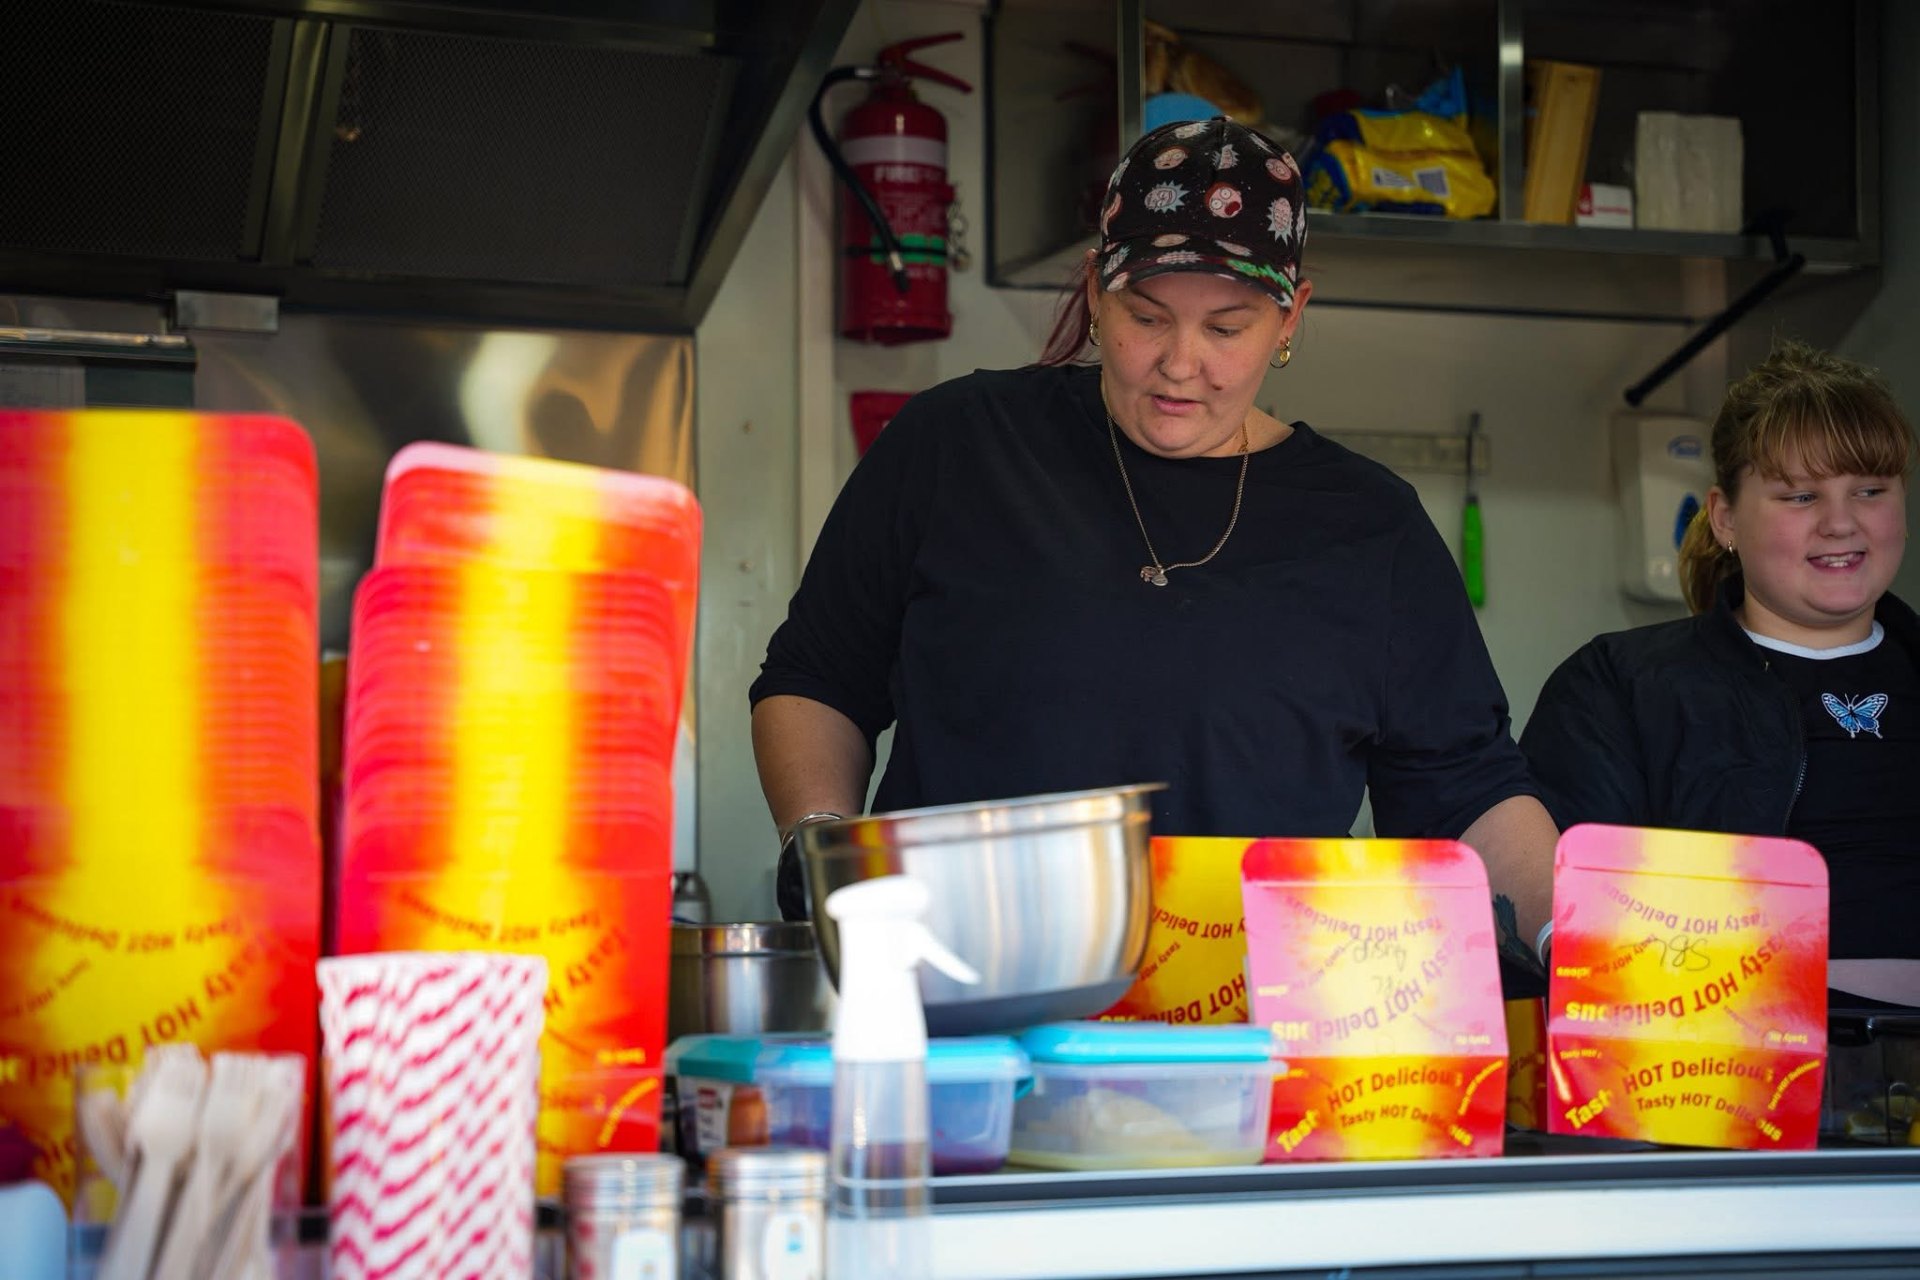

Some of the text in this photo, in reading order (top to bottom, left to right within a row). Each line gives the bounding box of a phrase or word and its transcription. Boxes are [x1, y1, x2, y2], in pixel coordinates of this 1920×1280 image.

[1152, 907, 1200, 937] Delici
[1201, 922, 1234, 940] HOT
[1367, 926, 1398, 942] HOT
[1682, 917, 1719, 936] HOT
[1725, 911, 1770, 934] Tasty
[1740, 934, 1784, 981] asty
[1208, 972, 1248, 1016] HOT
[1384, 978, 1425, 1023] HOT
[1694, 971, 1741, 1013] HOT
[1327, 1076, 1364, 1113] HOT
[1622, 1063, 1664, 1096] HOT
[1380, 1104, 1408, 1119] HOT
[1636, 1094, 1677, 1111] Tasty
[1680, 1093, 1713, 1108] HOT
